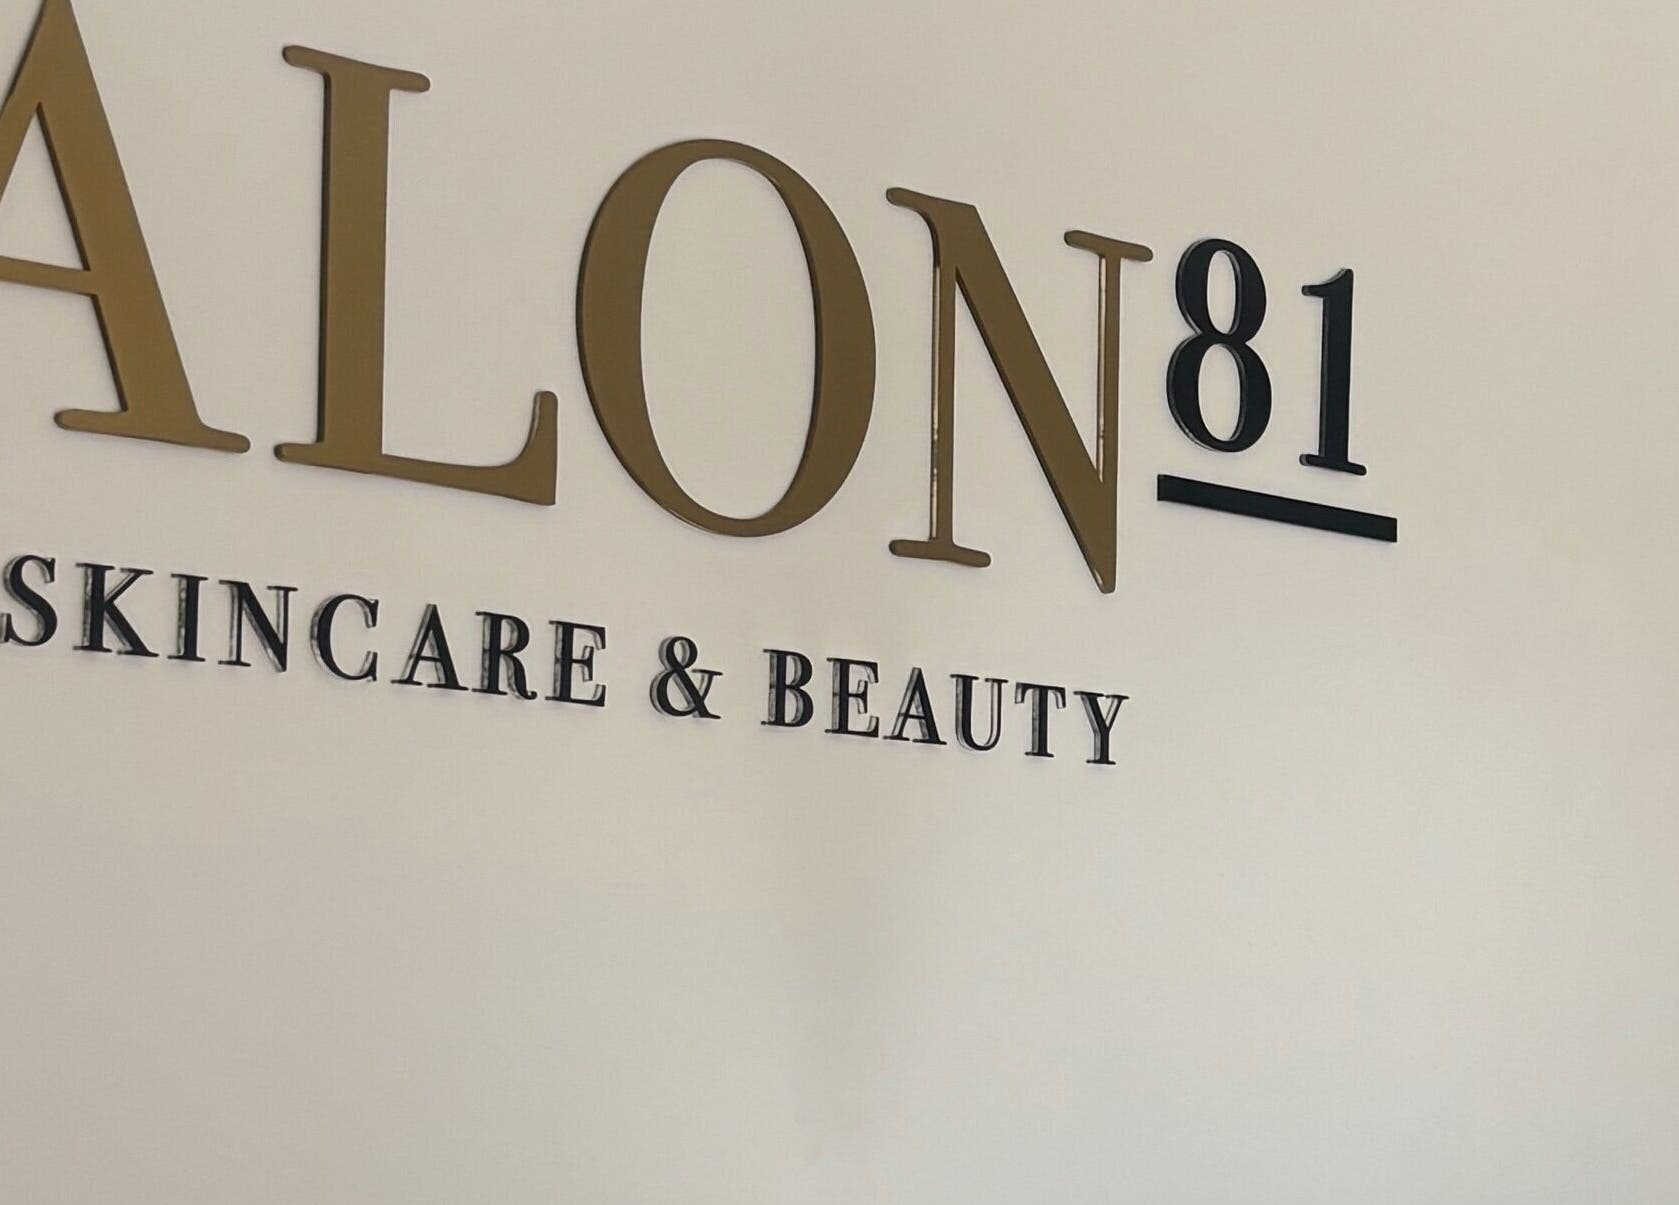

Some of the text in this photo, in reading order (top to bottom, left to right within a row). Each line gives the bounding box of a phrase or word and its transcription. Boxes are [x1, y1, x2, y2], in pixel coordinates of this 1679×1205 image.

[1166, 238, 1367, 476] 81
[0, 554, 1130, 766] SKINCARE & BEAUTY
